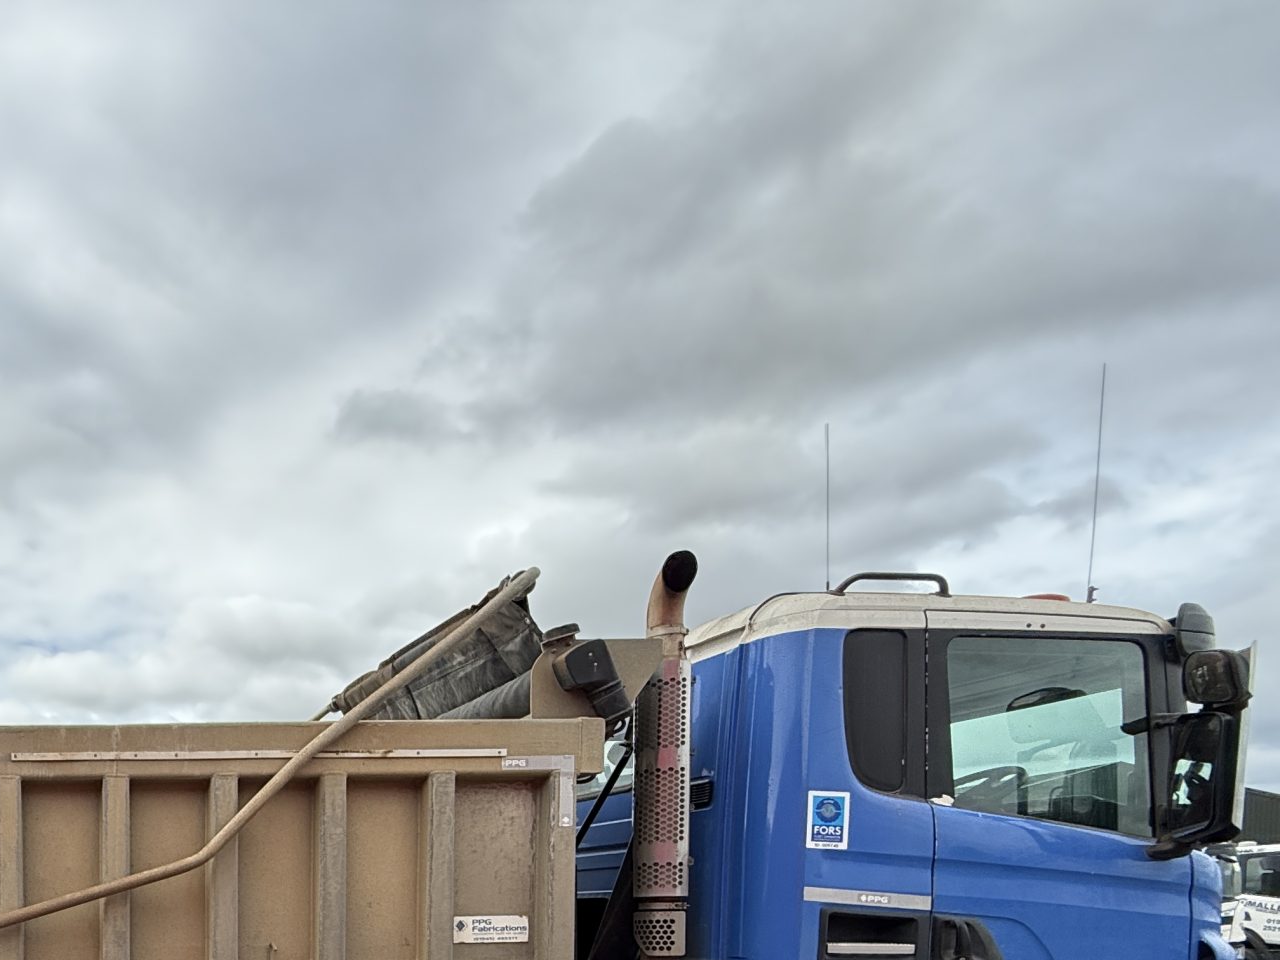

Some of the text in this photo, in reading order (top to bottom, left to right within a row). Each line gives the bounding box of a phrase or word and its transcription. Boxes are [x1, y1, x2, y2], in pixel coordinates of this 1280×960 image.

[505, 759, 526, 767] PPG
[813, 825, 842, 836] FORS
[867, 895, 888, 904] PPG
